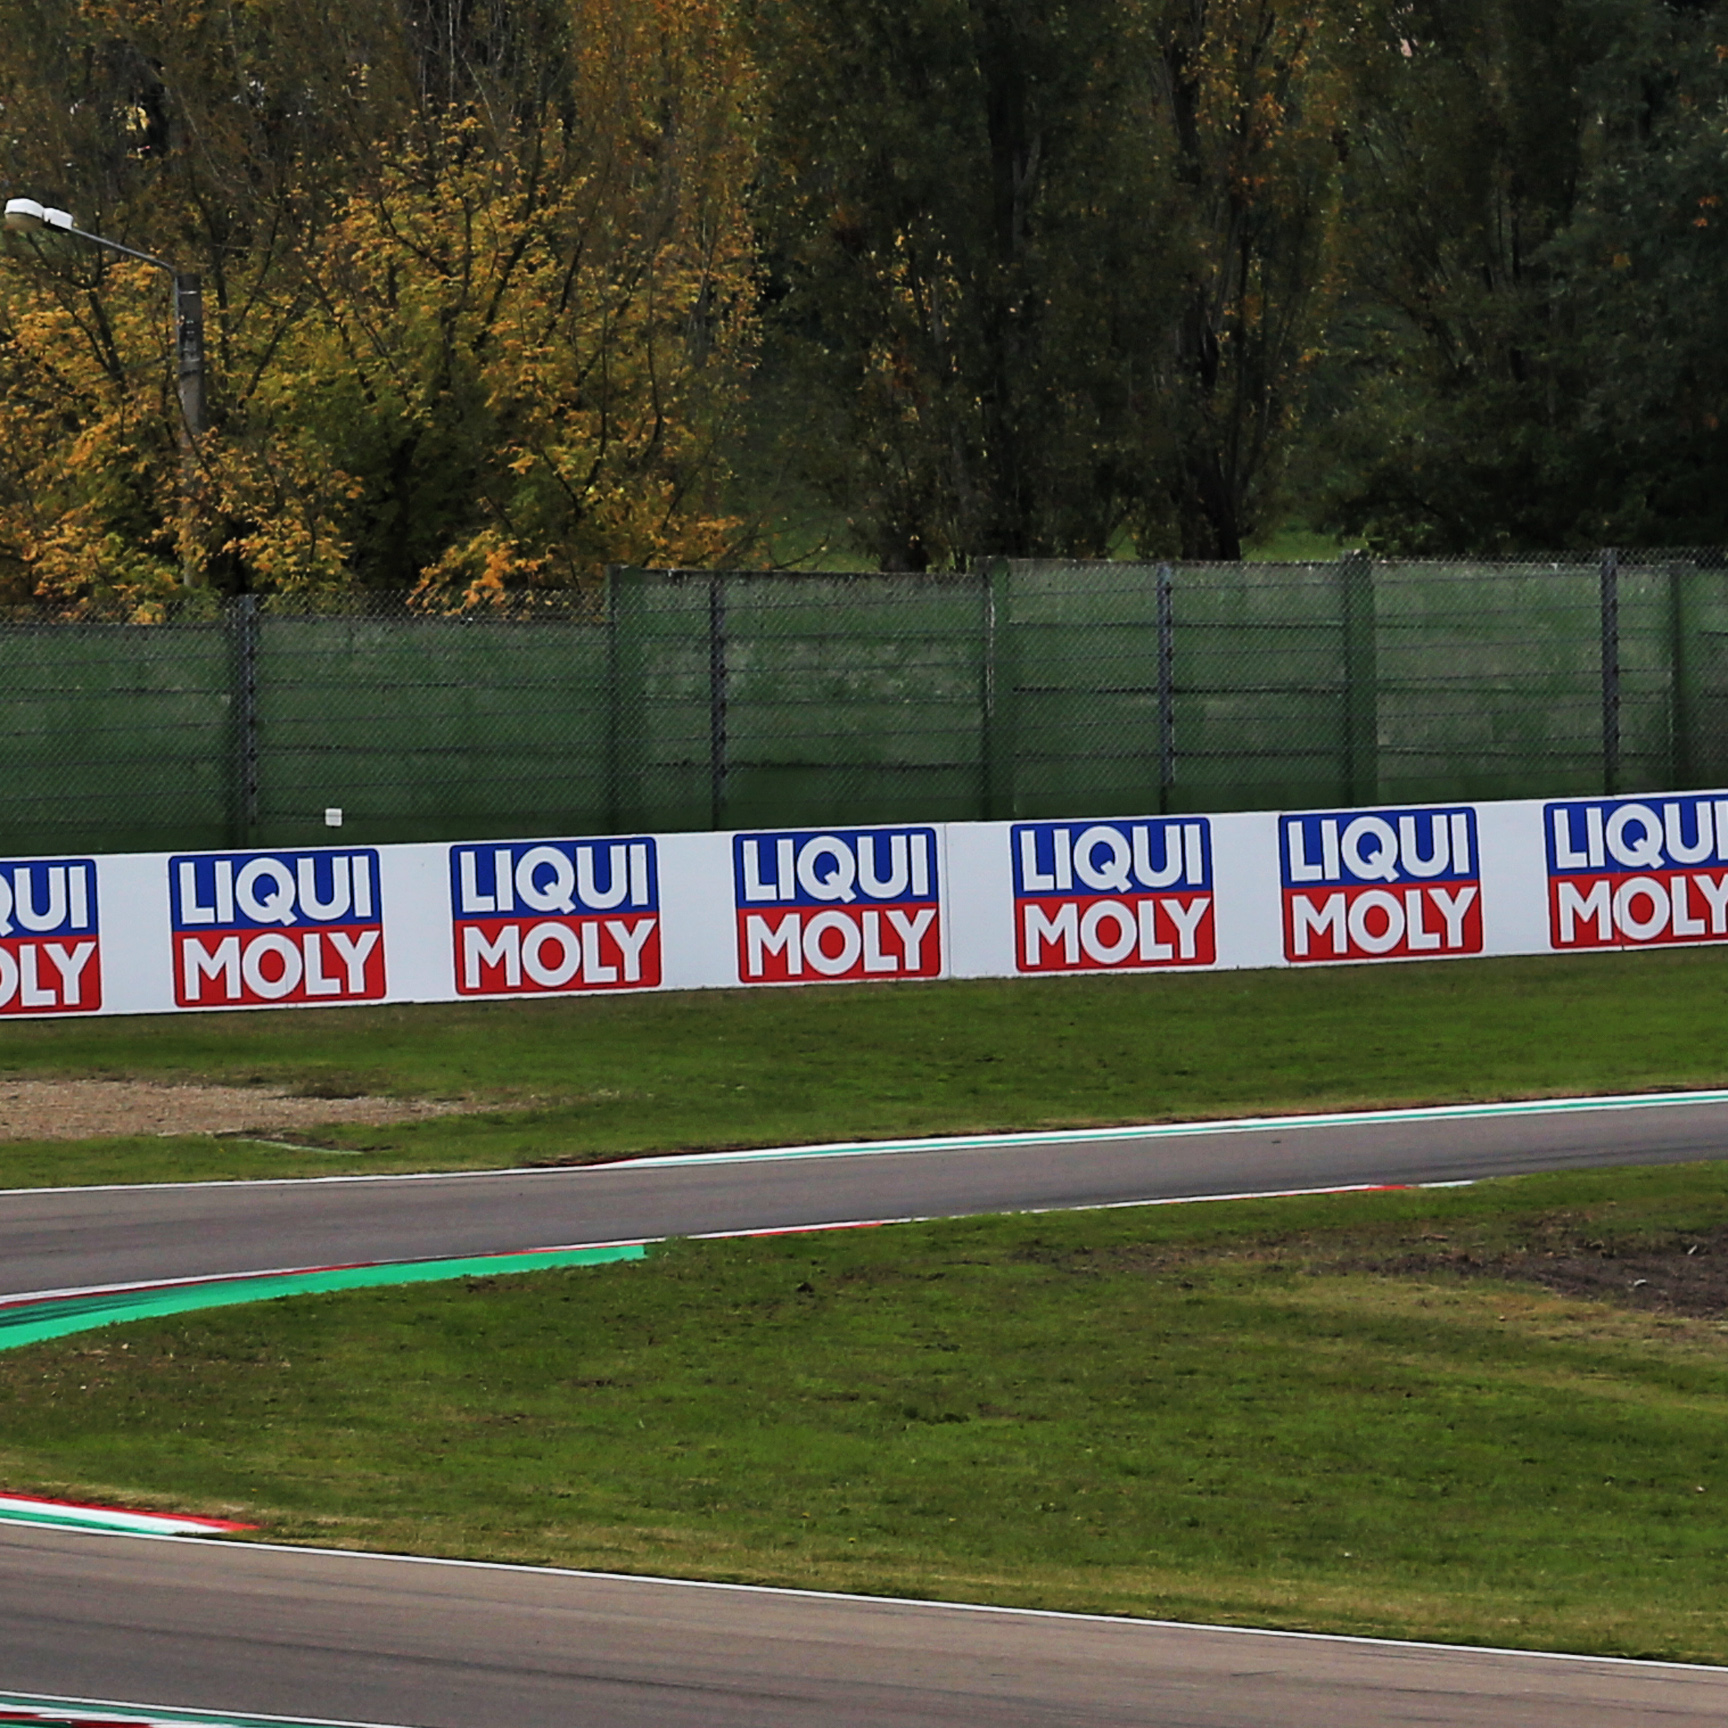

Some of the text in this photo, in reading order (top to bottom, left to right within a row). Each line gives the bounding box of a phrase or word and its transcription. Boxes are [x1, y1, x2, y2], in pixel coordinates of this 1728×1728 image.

[743, 835, 927, 902] LIQUI
[1021, 825, 1201, 892] LIQUI
[1289, 814, 1468, 882] LIQUI
[1554, 801, 1728, 869] LIQUI
[179, 856, 371, 925] LIQUI
[460, 844, 648, 914] LIQUI
[1560, 876, 1728, 943] MOLY
[465, 921, 656, 989] MOLY
[748, 911, 936, 977] MOLY
[1026, 899, 1211, 966] MOLY
[1294, 889, 1478, 956] MOLY
[184, 932, 380, 1001] MOLY
